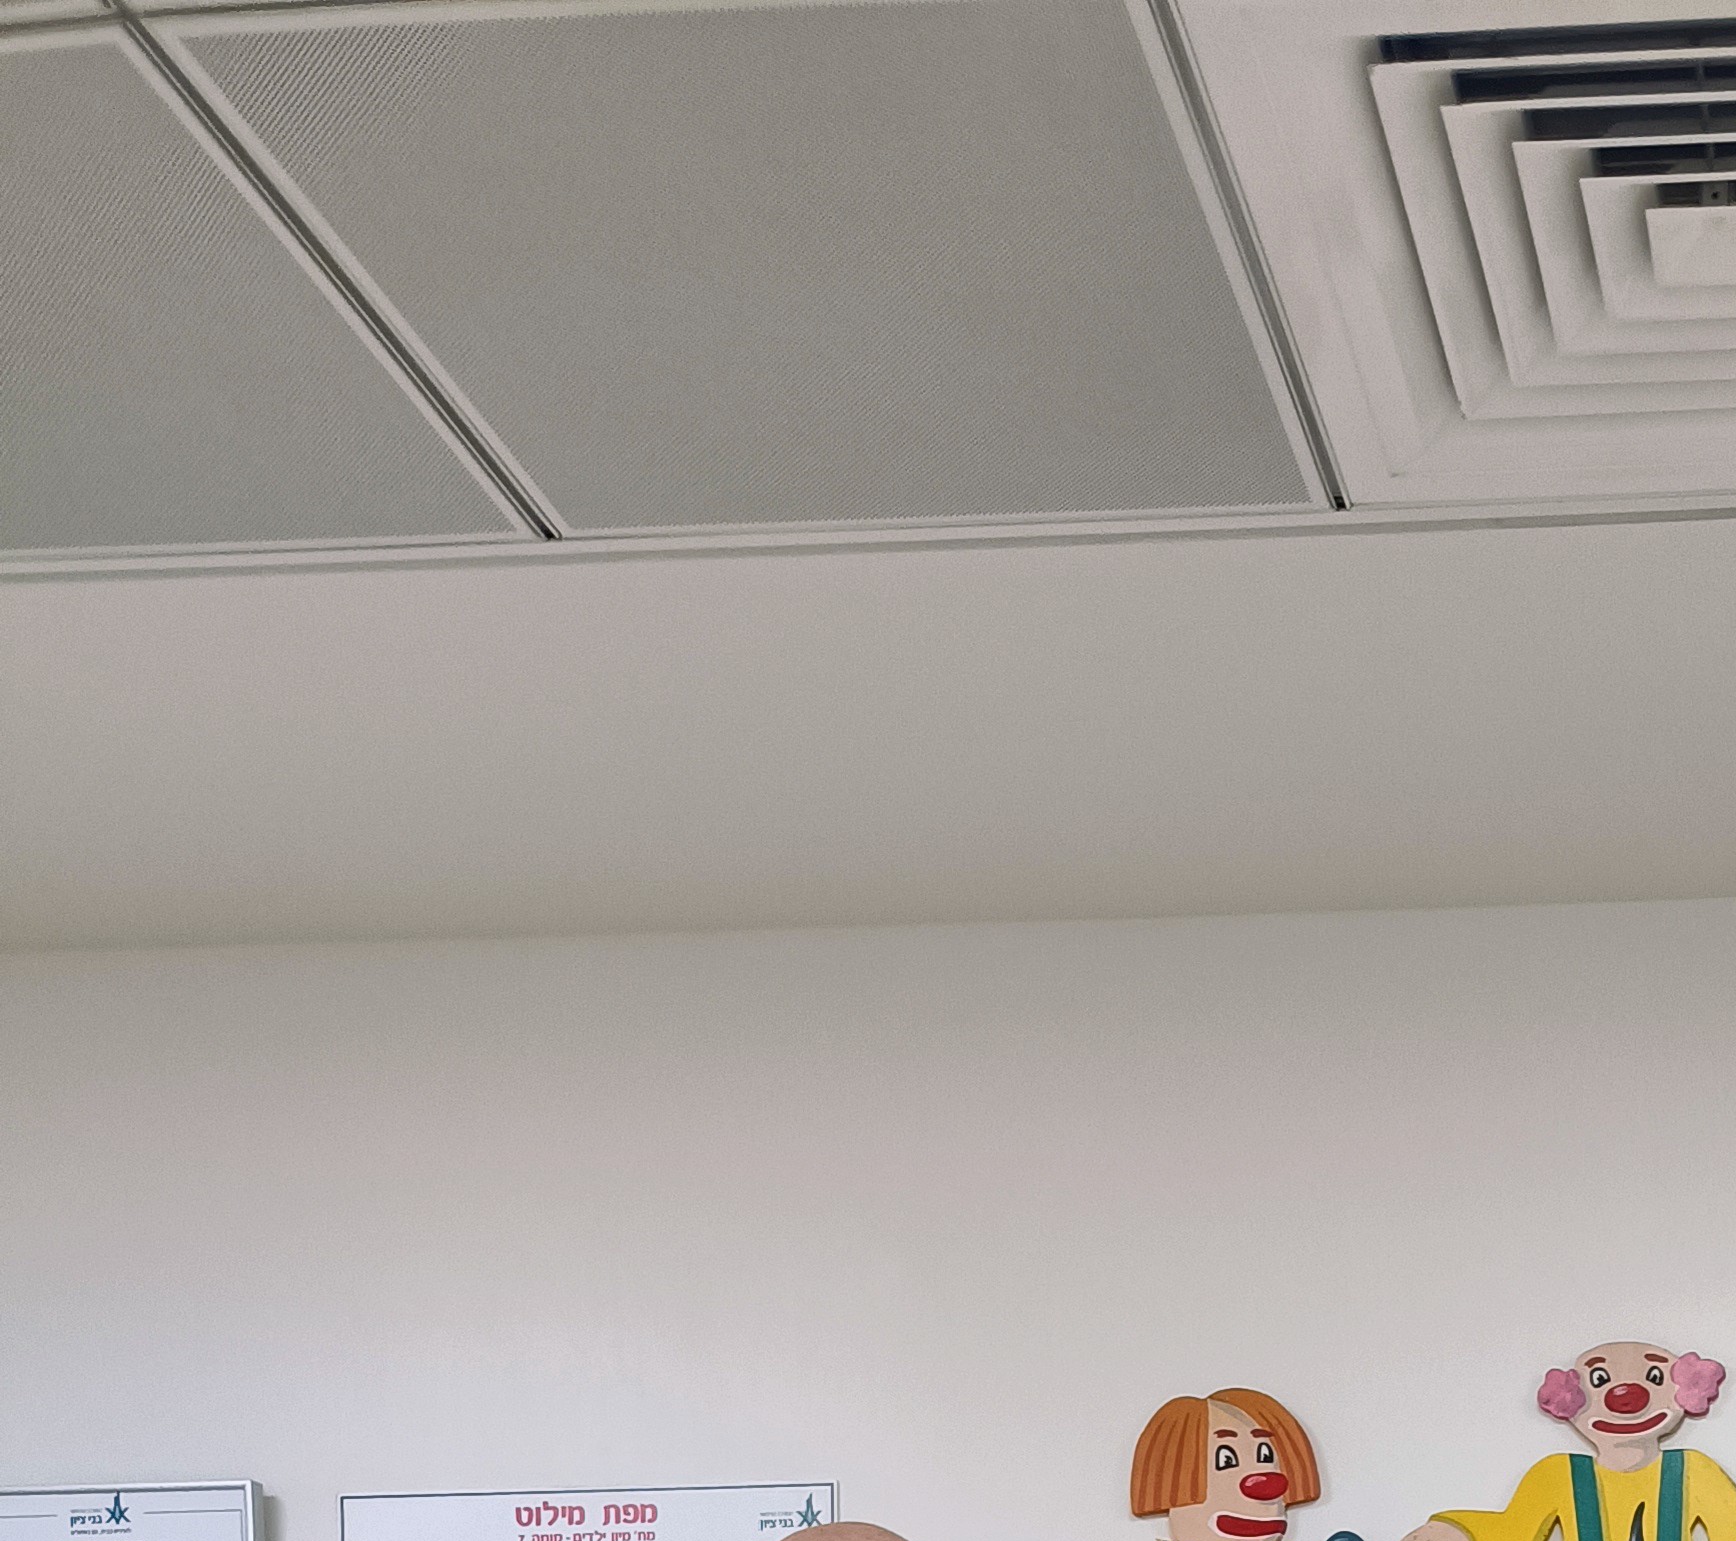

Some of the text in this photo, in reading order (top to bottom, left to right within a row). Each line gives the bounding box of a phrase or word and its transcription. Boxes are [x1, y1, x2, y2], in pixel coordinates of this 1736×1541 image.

[515, 1501, 658, 1527] מפת מילוט
[759, 1519, 794, 1531] בני ציון
